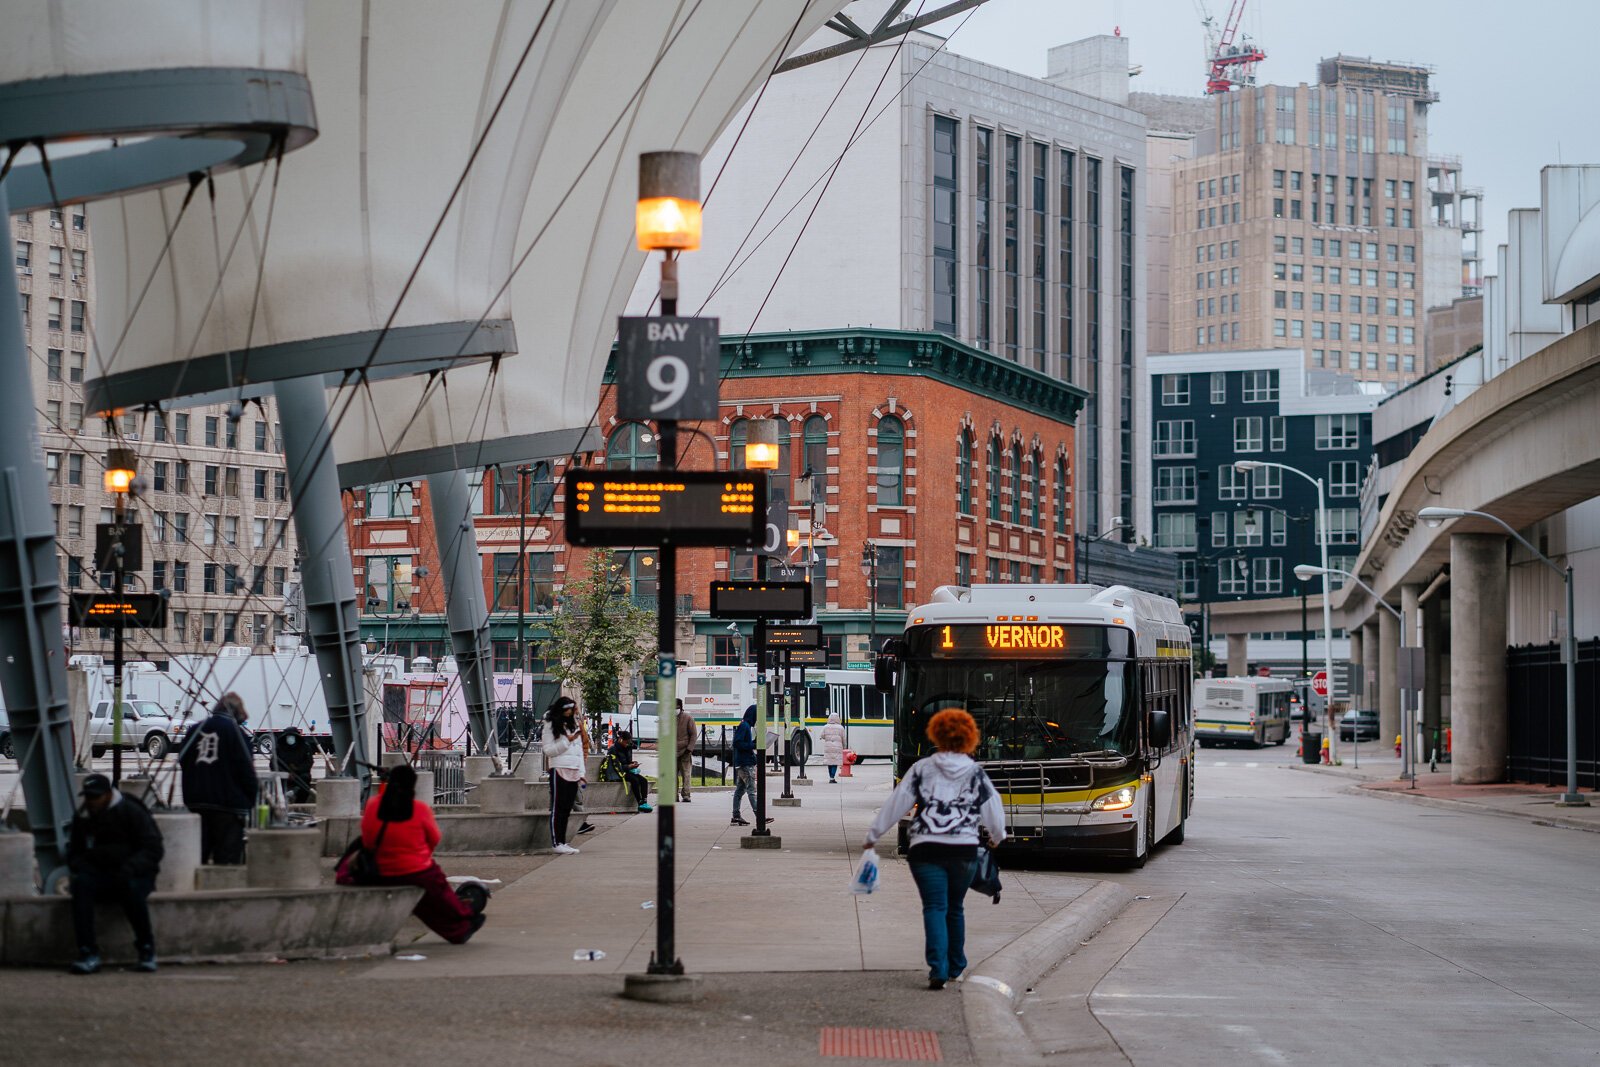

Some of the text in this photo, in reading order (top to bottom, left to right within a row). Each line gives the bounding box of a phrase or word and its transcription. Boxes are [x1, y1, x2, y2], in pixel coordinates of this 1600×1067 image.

[647, 323, 689, 341] BAY
[646, 355, 690, 413] 9
[108, 527, 127, 536] BAY
[942, 625, 1064, 648] 1 VERNOR
[661, 661, 673, 676] 2
[1313, 679, 1328, 689] STO
[196, 732, 219, 765] D
